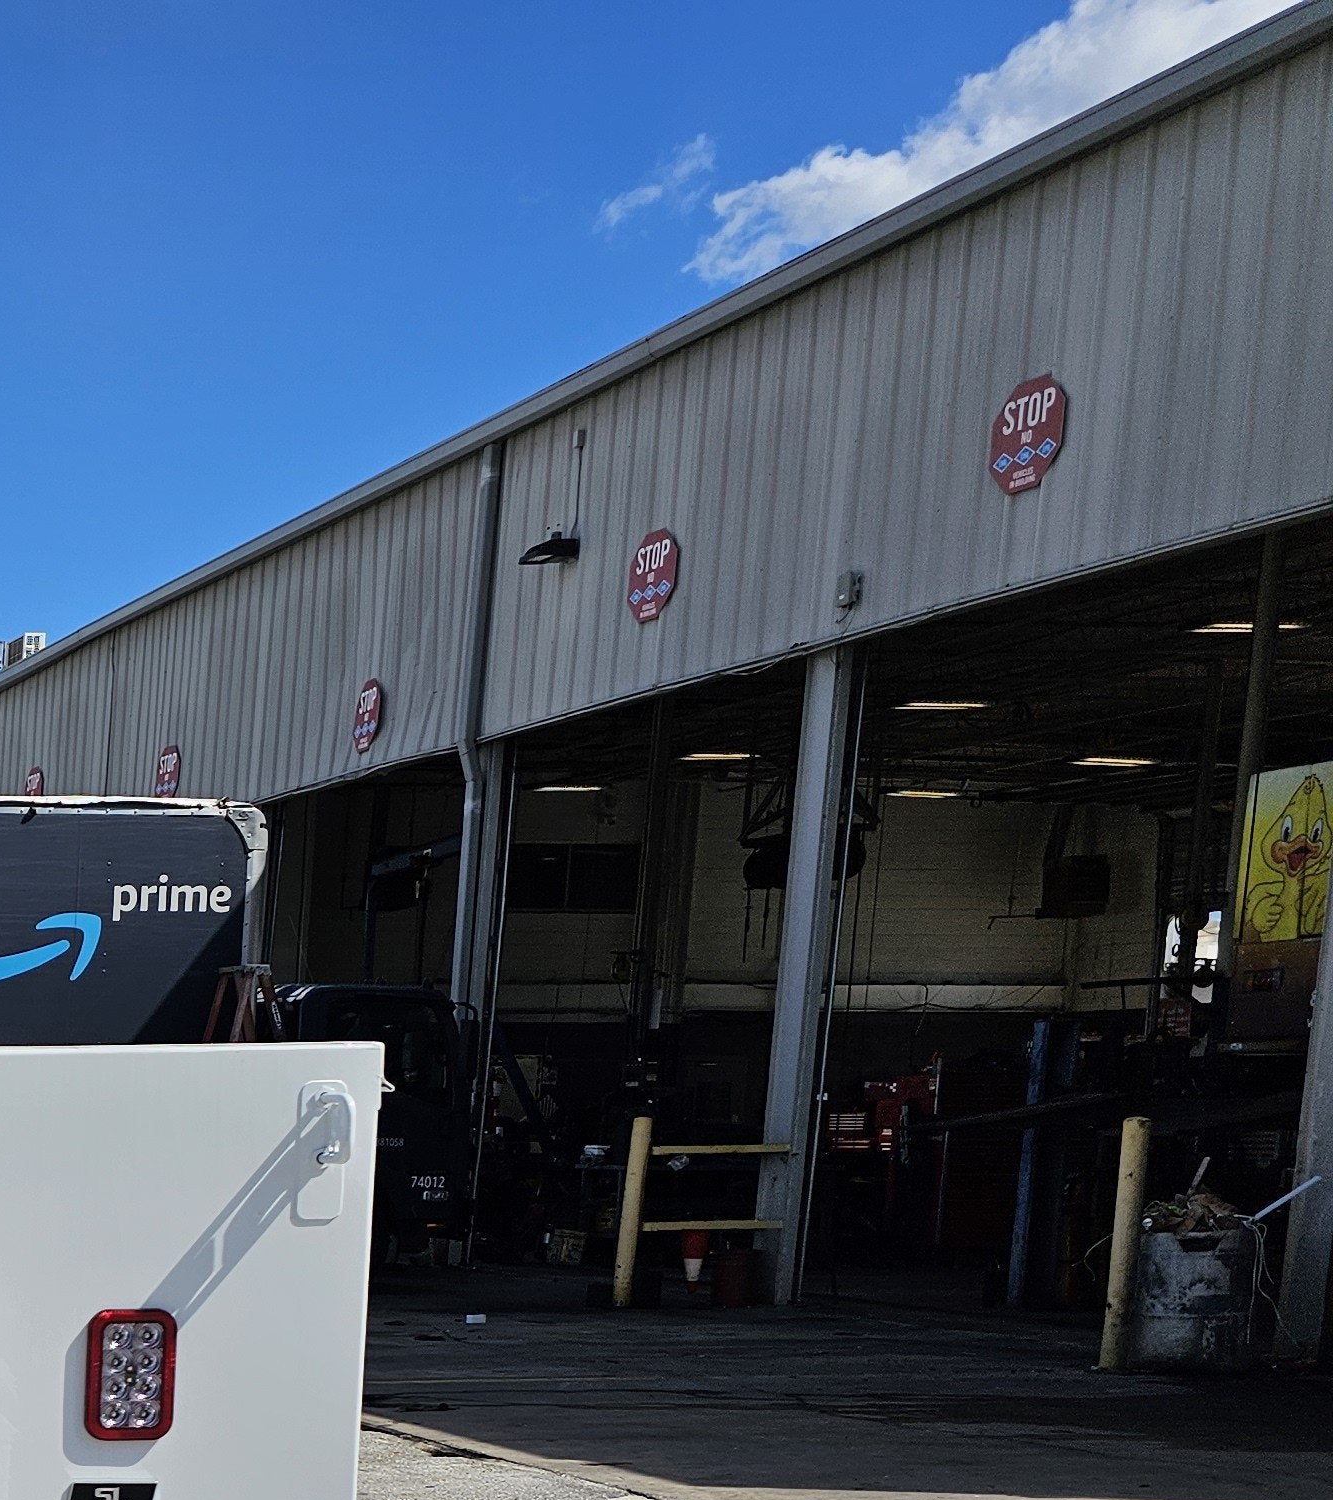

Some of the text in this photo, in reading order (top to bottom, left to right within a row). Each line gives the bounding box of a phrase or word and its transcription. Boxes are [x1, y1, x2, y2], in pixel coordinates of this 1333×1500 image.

[1002, 387, 1056, 436] STOP
[1020, 429, 1033, 445] NO
[636, 539, 670, 575] STOP
[359, 686, 377, 715] STOP
[159, 752, 177, 775] STOP
[112, 874, 232, 922] prime
[411, 1175, 446, 1189] 74012
